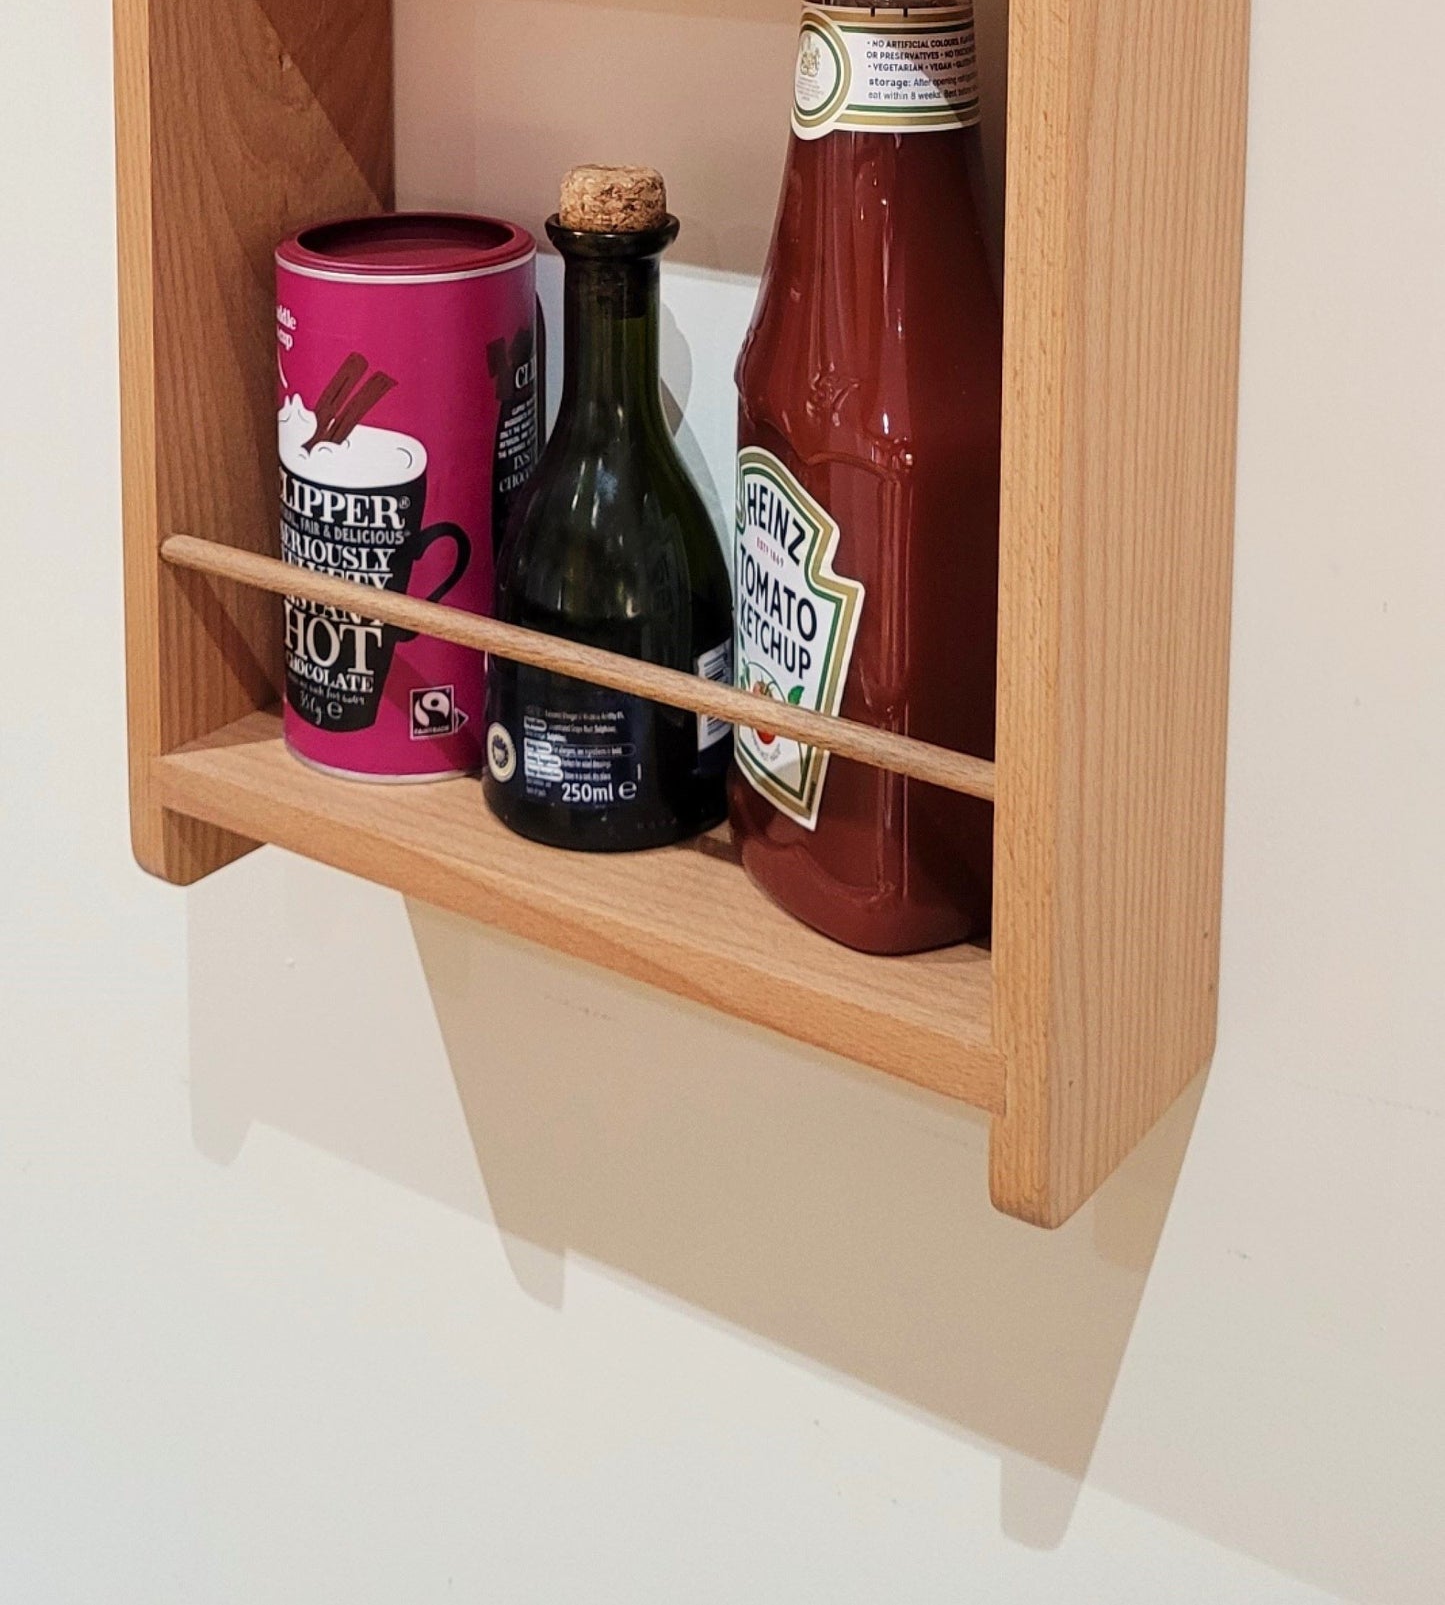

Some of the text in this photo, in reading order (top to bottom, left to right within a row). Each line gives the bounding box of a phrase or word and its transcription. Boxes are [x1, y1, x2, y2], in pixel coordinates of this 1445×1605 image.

[872, 38, 959, 49] NO ARTIFICIAL COLOURS
[866, 51, 878, 59] OR
[880, 51, 940, 60] PRESERVATIVES
[873, 62, 952, 72] VEGETARIAN VEGAN
[869, 78, 911, 90] storage:
[913, 78, 931, 87] After
[868, 91, 881, 99] eat
[884, 91, 908, 100] within
[280, 472, 407, 530] LIPPER
[747, 482, 806, 567] HEINZ
[323, 525, 331, 538] &
[334, 526, 405, 545] DELICIOUS
[740, 542, 818, 643] TOMATO
[284, 599, 382, 675] HOT
[740, 594, 811, 680] KETCHUP
[561, 782, 614, 802] 250ml
